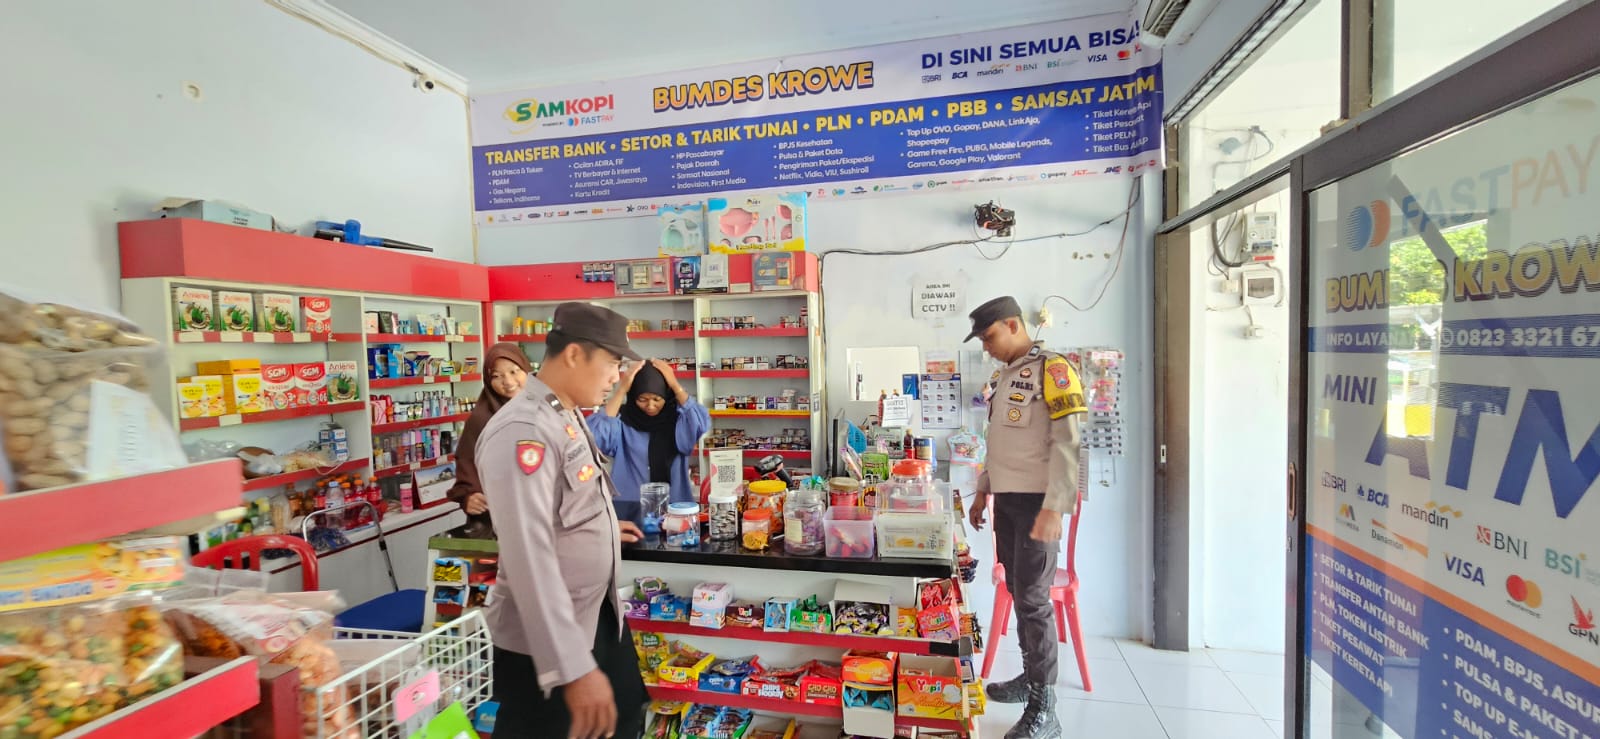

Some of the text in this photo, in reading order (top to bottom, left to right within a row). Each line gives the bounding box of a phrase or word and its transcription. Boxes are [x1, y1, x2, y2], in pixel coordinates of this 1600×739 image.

[921, 52, 943, 69] DI
[949, 45, 992, 66] SINI
[999, 35, 1081, 60] SEMUA
[952, 71, 968, 80] BCA
[1087, 54, 1108, 63] VISA
[653, 60, 875, 113] BUMDES KROWE
[516, 94, 614, 122] SAMKOPI
[1093, 100, 1152, 119] Tiket Api
[485, 74, 1156, 165] TRANSFER BANK SETOR & TARIK TUNAI PLN PDAM PBB SAMSAT JATM
[581, 115, 614, 125] FASTPAY
[1092, 121, 1113, 130] Tiket
[906, 129, 921, 137] Top
[921, 127, 933, 136] Up
[932, 125, 953, 134] OVO,
[953, 122, 981, 133] Gopay,
[981, 120, 1008, 129] DANA,
[796, 138, 833, 148] Kesehatan
[906, 137, 950, 148] Shopeepay
[1092, 132, 1113, 142] Tiket
[778, 151, 798, 160] Pulsa
[804, 149, 825, 158] Paket
[825, 148, 843, 156] Data
[906, 137, 1053, 158] Game Free Fire, PUBG, Mobile Legends,
[1092, 143, 1130, 153] Tiket Bus
[676, 161, 694, 170] Pajak
[779, 159, 819, 171] Pengiriman
[938, 157, 967, 167] Google
[967, 155, 986, 165] Play,
[987, 152, 1021, 162] Valorant
[582, 169, 611, 179] Berbayar
[616, 167, 641, 175] Internet
[701, 169, 730, 178] Nasional
[804, 170, 825, 179] Vidio,
[839, 166, 870, 176] Sushiroll
[711, 178, 726, 187] First
[725, 176, 747, 186] Media
[1402, 136, 1600, 235] FASTPAY
[921, 292, 956, 300] DIAWASI
[311, 300, 326, 309] SGM
[921, 303, 956, 313] CCTV !!
[1326, 333, 1353, 345] INFO
[1457, 328, 1505, 347] 0823
[1511, 328, 1564, 347] 3321
[267, 367, 287, 379] SGM
[302, 367, 320, 377] SGM
[328, 363, 356, 371] Anlene
[1010, 380, 1034, 391] POLRI
[1324, 374, 1377, 405] MINI
[1365, 382, 1600, 519] ATM
[1367, 488, 1389, 508] BCA
[1401, 502, 1449, 529] mandiri
[1494, 532, 1528, 560] BNI
[1545, 548, 1580, 578] BSI
[1320, 553, 1417, 616] SETOR & TARIK TUNAI
[701, 591, 716, 601] Yupi
[1444, 552, 1486, 586] VISA
[1568, 623, 1600, 646] GPN
[738, 607, 753, 617] Yupi
[1320, 573, 1429, 650] TRANSFER ANTAR BANK
[926, 612, 947, 626] Yupi
[1320, 592, 1408, 660] PLN, TOKEN LISTRIK
[1320, 611, 1385, 666] TIKET PESAWAT
[1319, 631, 1393, 697] TIKET KERETA API
[1455, 628, 1500, 668] PDAM,
[1503, 656, 1549, 697] BPJS,
[916, 678, 942, 693] Yupi
[1454, 681, 1506, 725] TOP UP
[1455, 655, 1579, 738] PULSA & PAKET
